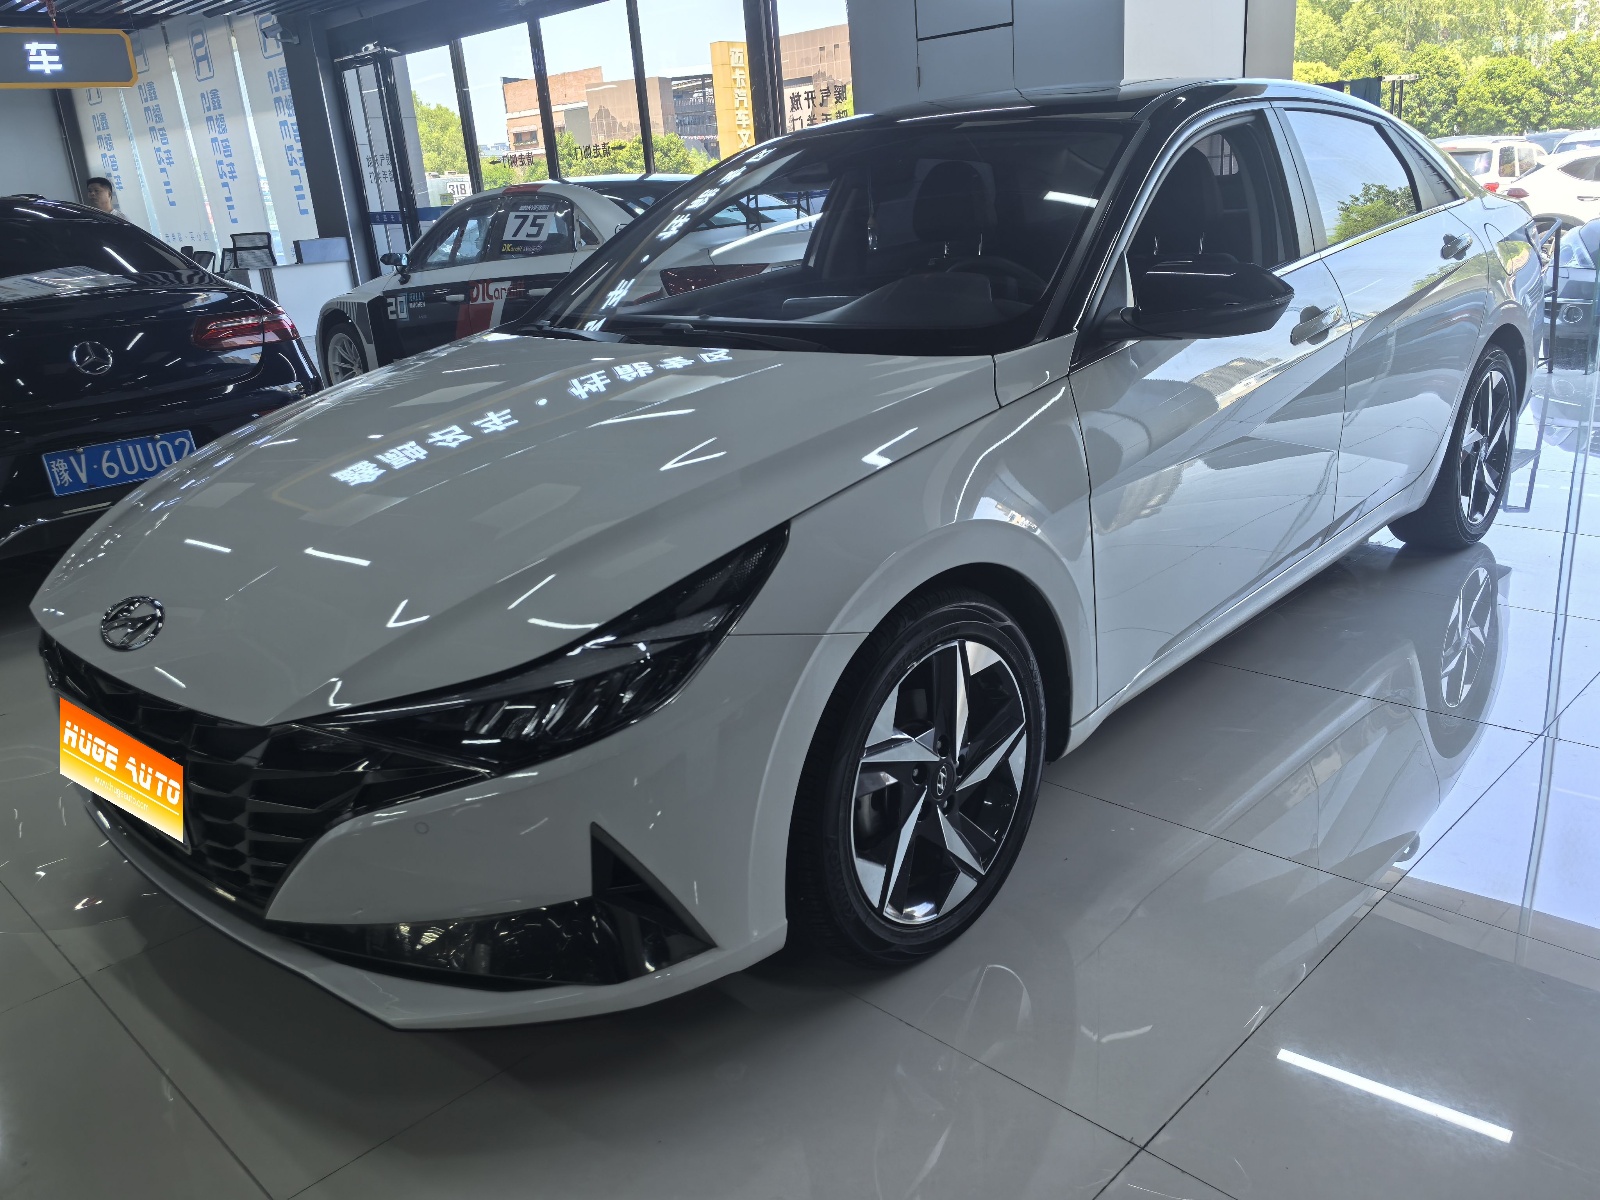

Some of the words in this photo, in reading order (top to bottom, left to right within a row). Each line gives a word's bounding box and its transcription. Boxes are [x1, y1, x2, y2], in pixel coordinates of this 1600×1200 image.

[25, 42, 62, 74] 车
[448, 183, 467, 196] 318
[511, 214, 548, 238] 75
[386, 297, 408, 320] 20
